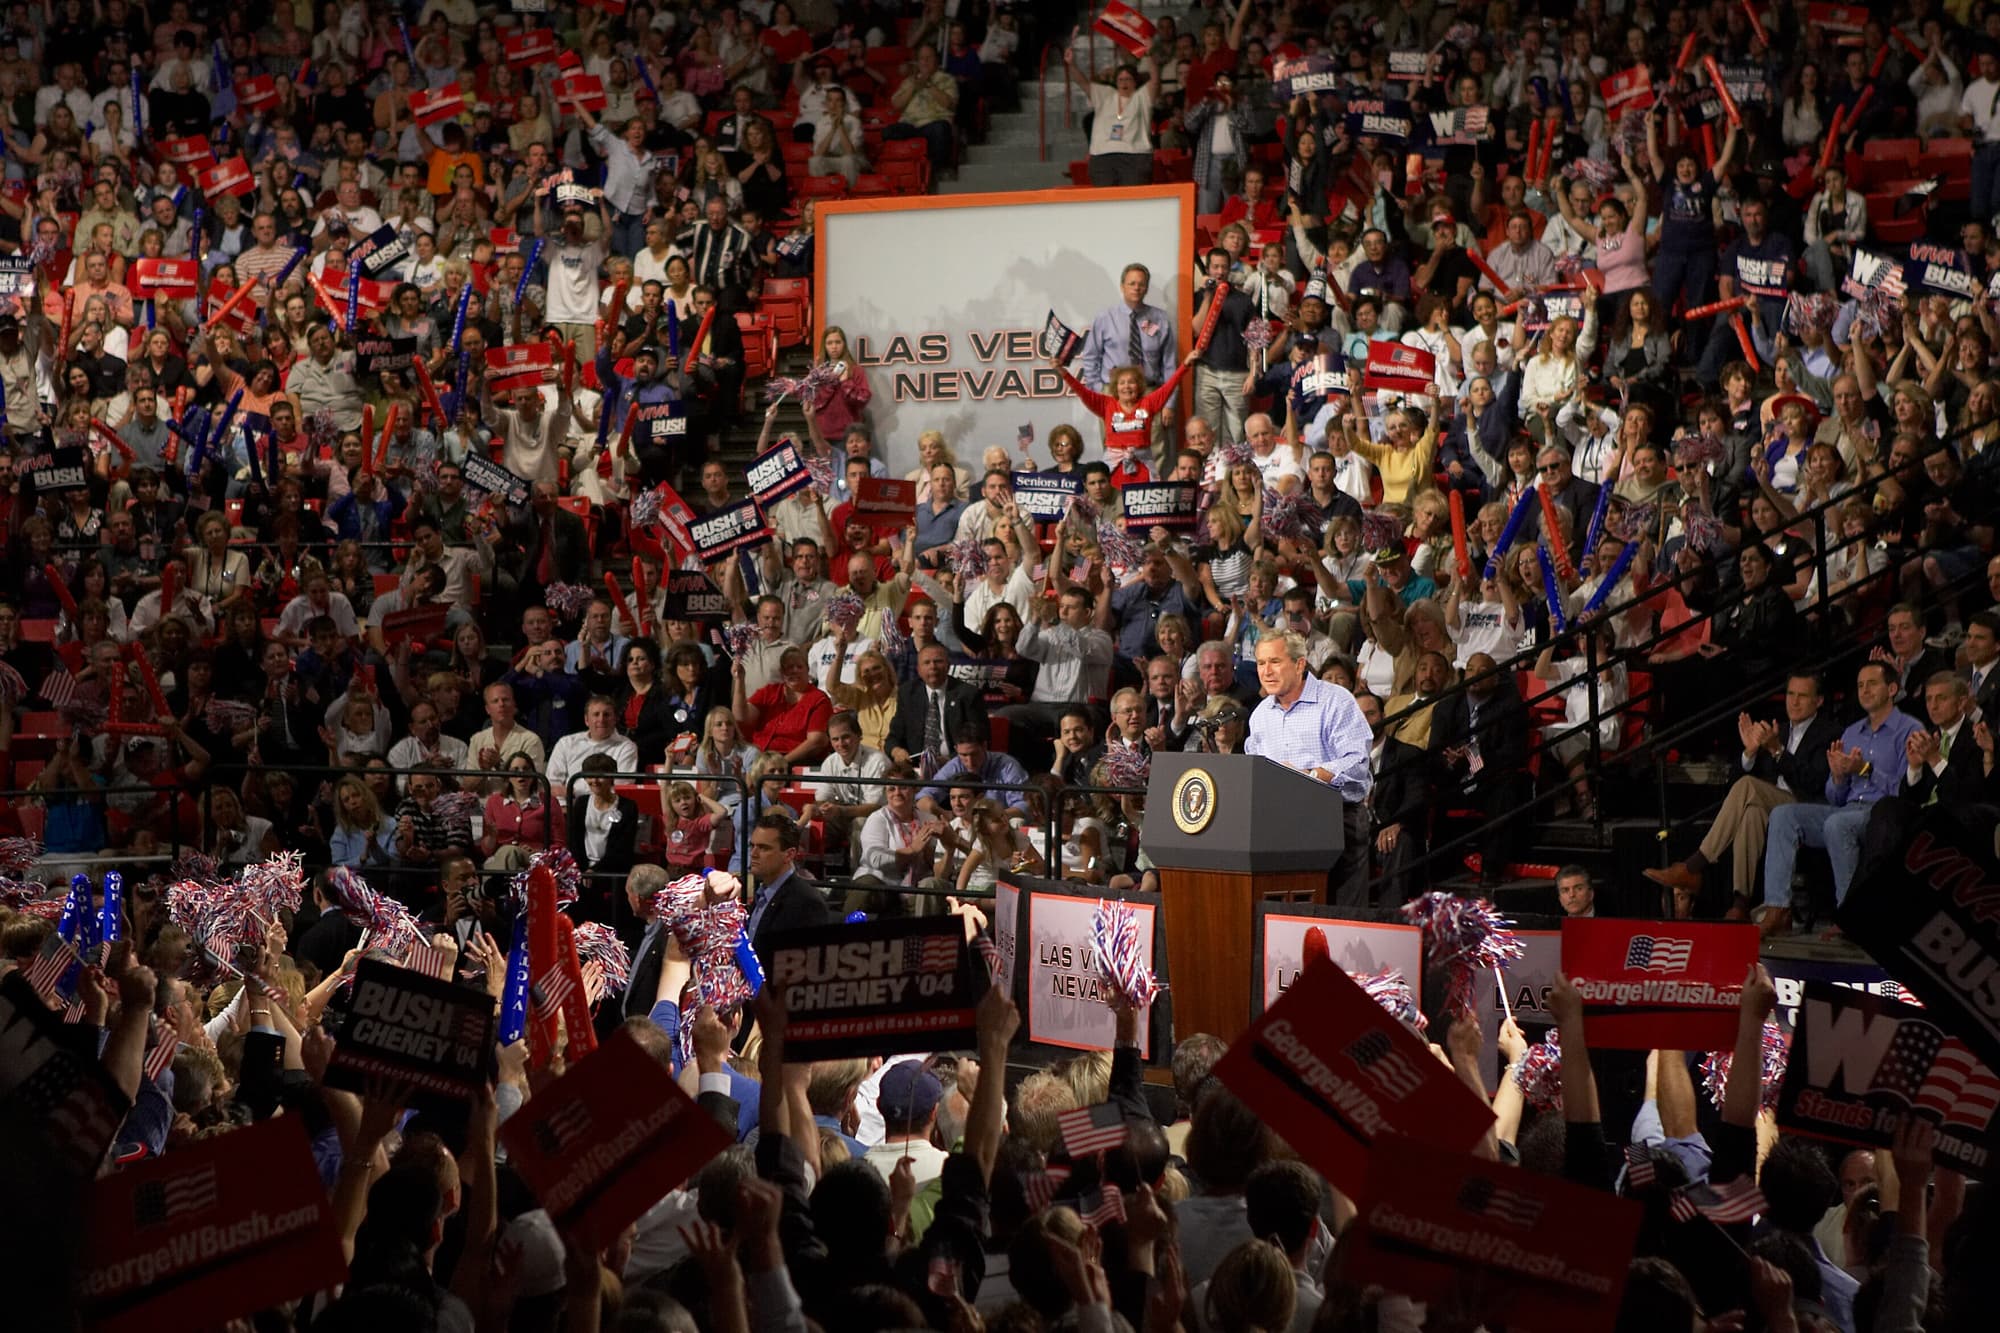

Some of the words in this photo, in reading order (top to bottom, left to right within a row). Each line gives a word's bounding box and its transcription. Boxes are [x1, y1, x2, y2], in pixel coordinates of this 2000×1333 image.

[1291, 72, 1335, 92] BUSH
[1347, 101, 1385, 115] VIVA
[1362, 114, 1407, 134] BUSH
[1429, 111, 1454, 137] W
[556, 184, 594, 202] BUSH
[364, 239, 405, 271] BUSH
[1852, 247, 1881, 285] W
[1910, 242, 1955, 267] VIVA
[357, 341, 392, 355] VIVA
[859, 333, 949, 367] LAS
[636, 403, 670, 422] VIVA
[651, 417, 687, 434] BUSH
[12, 453, 55, 476] VIVA
[33, 466, 85, 488] BUSH
[465, 459, 511, 491] BUSH
[746, 452, 781, 487] BUSH
[752, 469, 787, 495] CHENEY
[785, 459, 799, 473] '04
[1016, 476, 1058, 489] Seniors
[1060, 477, 1078, 490] for
[1015, 491, 1060, 507] BUSH
[1125, 488, 1175, 506] BUSH
[1129, 503, 1176, 516] CHENEY
[690, 510, 739, 542] BUSH
[699, 523, 743, 550] CHENEY
[740, 518, 758, 532] '04
[670, 576, 709, 594] VIVA
[947, 664, 986, 680] USH
[109, 872, 121, 902] GOP
[771, 939, 905, 984] BUSH
[1039, 942, 1074, 969] LAS
[1909, 909, 2000, 1014] BUS
[784, 977, 910, 1014] CHENEY
[914, 972, 955, 997] '04
[352, 978, 457, 1036] BUSH
[352, 1017, 451, 1064] CHENEY
[456, 1044, 481, 1070] '04
[1805, 1000, 1901, 1095] W
[1793, 1088, 1874, 1132] Stands
[1931, 1128, 1990, 1169] omen
[1368, 1201, 1615, 1294] GeorgeWBush.com
